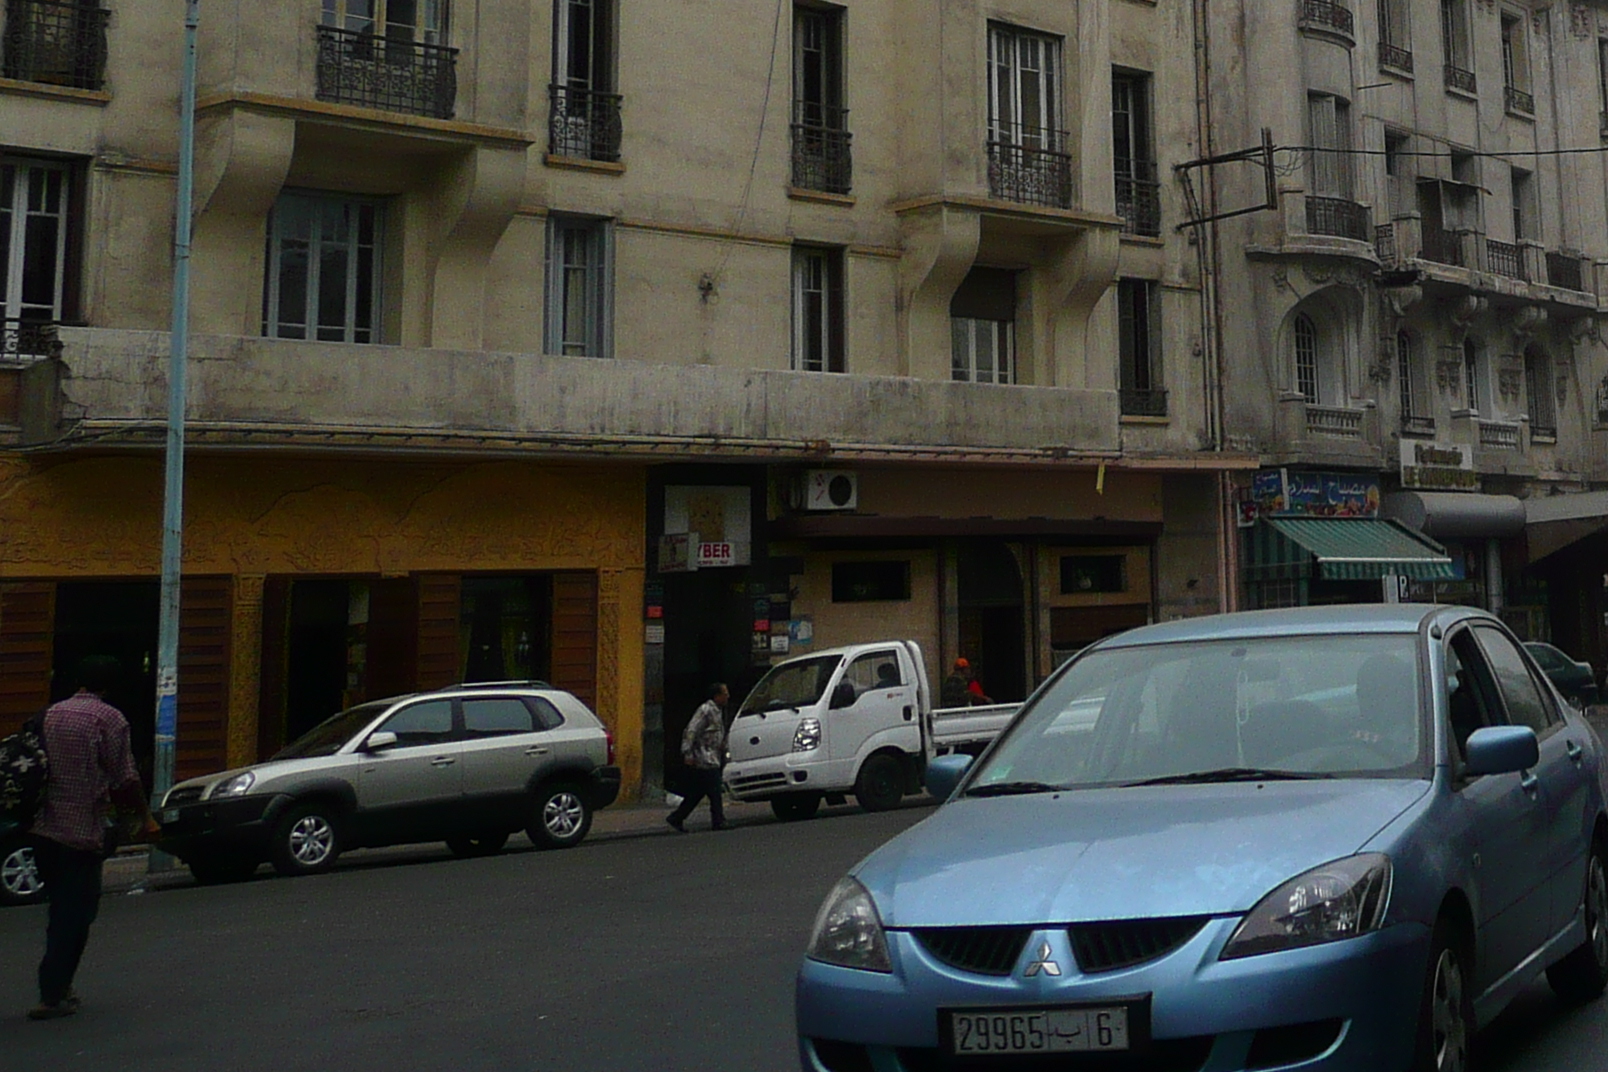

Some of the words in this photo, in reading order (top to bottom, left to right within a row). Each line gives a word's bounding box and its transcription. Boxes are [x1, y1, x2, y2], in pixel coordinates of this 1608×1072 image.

[1328, 476, 1365, 505] مصباح
[697, 543, 730, 558] YBER
[959, 1015, 1043, 1051] 29965
[1096, 1012, 1112, 1047] 6
